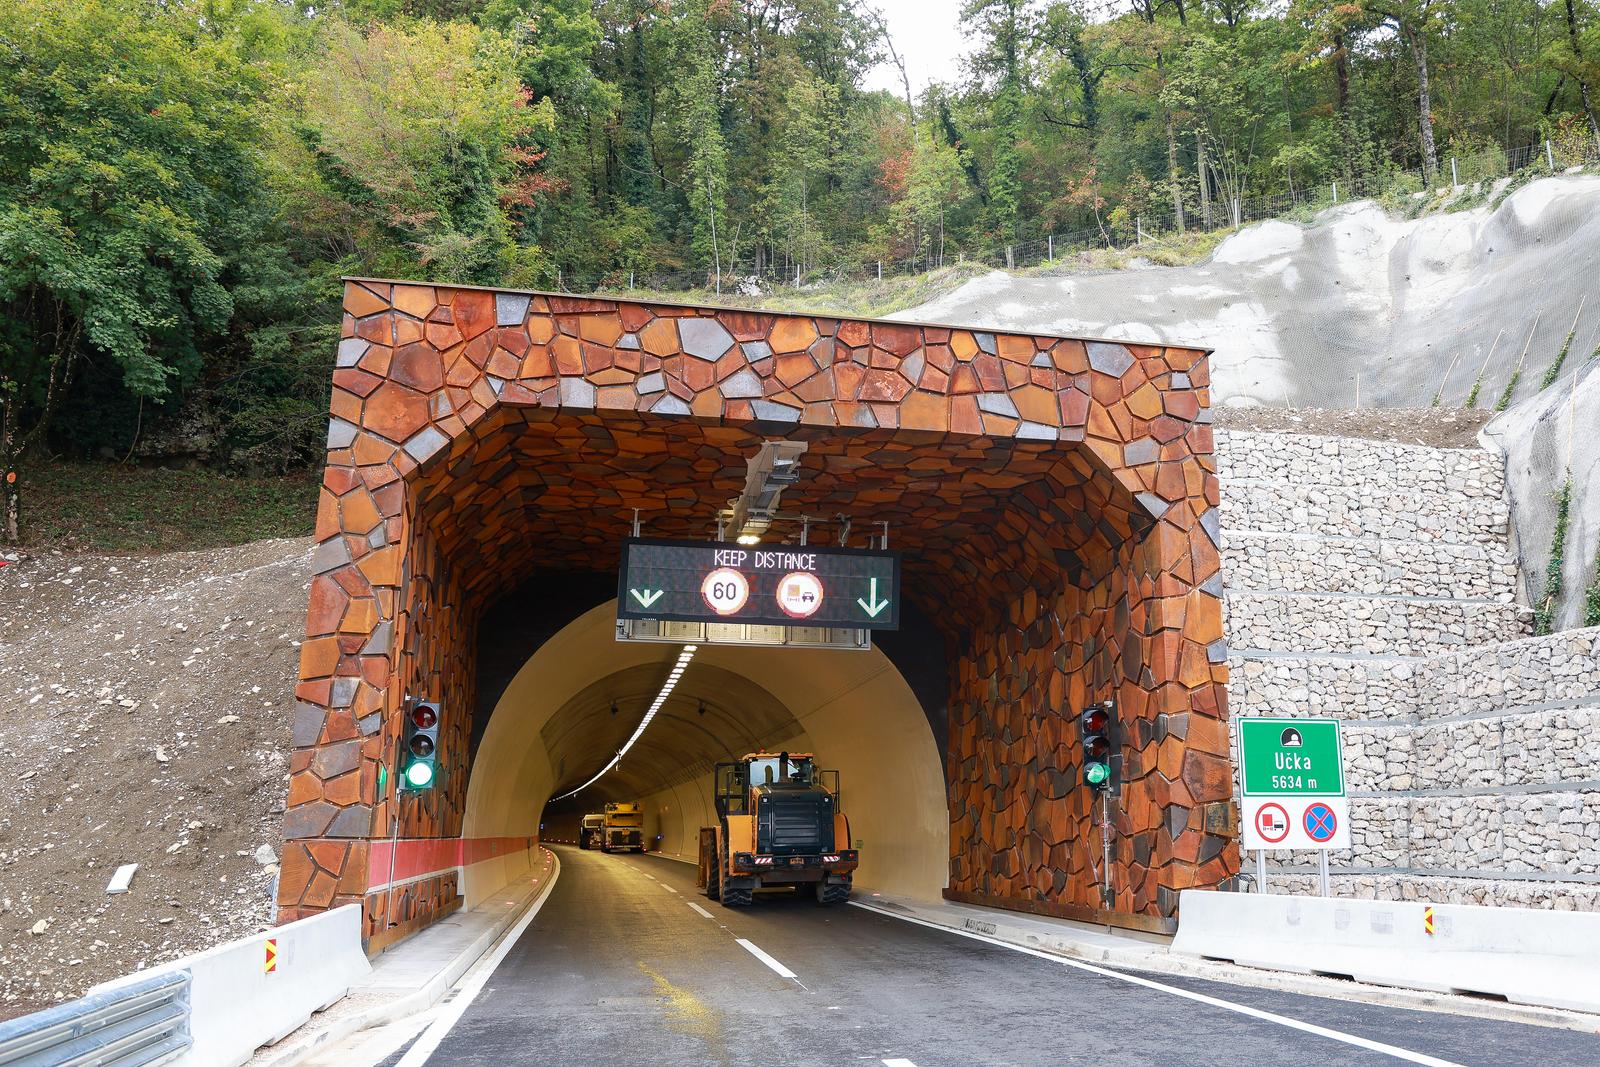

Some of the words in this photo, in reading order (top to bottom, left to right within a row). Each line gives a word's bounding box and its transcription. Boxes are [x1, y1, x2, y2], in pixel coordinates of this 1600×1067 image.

[714, 549, 747, 567] KEEP
[755, 553, 817, 570] DISTANCE
[713, 582, 737, 600] 60
[1275, 752, 1312, 770] Učka
[1272, 776, 1302, 789] 5634
[1308, 778, 1318, 789] m
